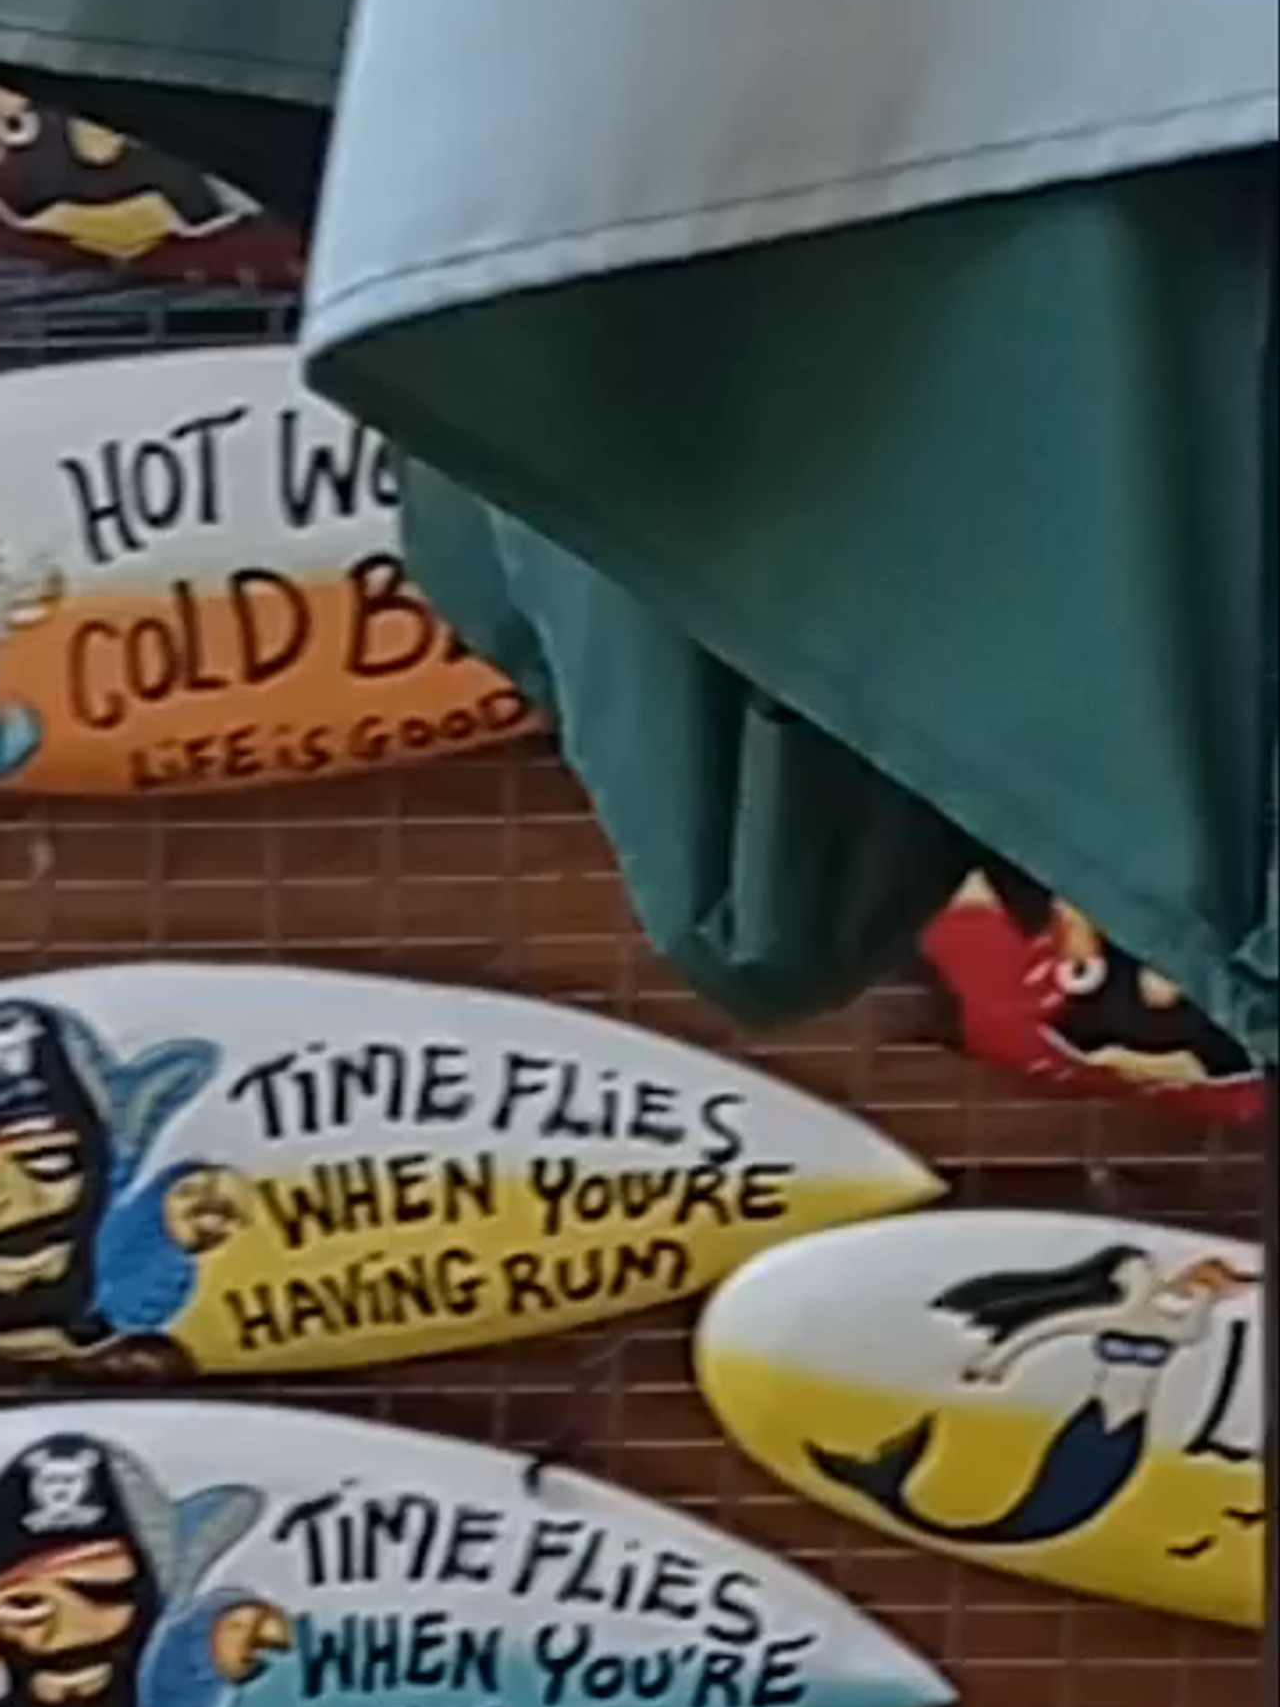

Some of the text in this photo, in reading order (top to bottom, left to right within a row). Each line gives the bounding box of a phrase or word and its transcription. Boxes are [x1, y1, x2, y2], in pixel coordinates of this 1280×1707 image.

[58, 405, 250, 564] HOT
[68, 568, 311, 728] COLD
[351, 687, 532, 761] GOOD
[255, 1152, 497, 1250] WHEN
[501, 1238, 695, 1315] RUM
[293, 1609, 502, 1697] WHEN
